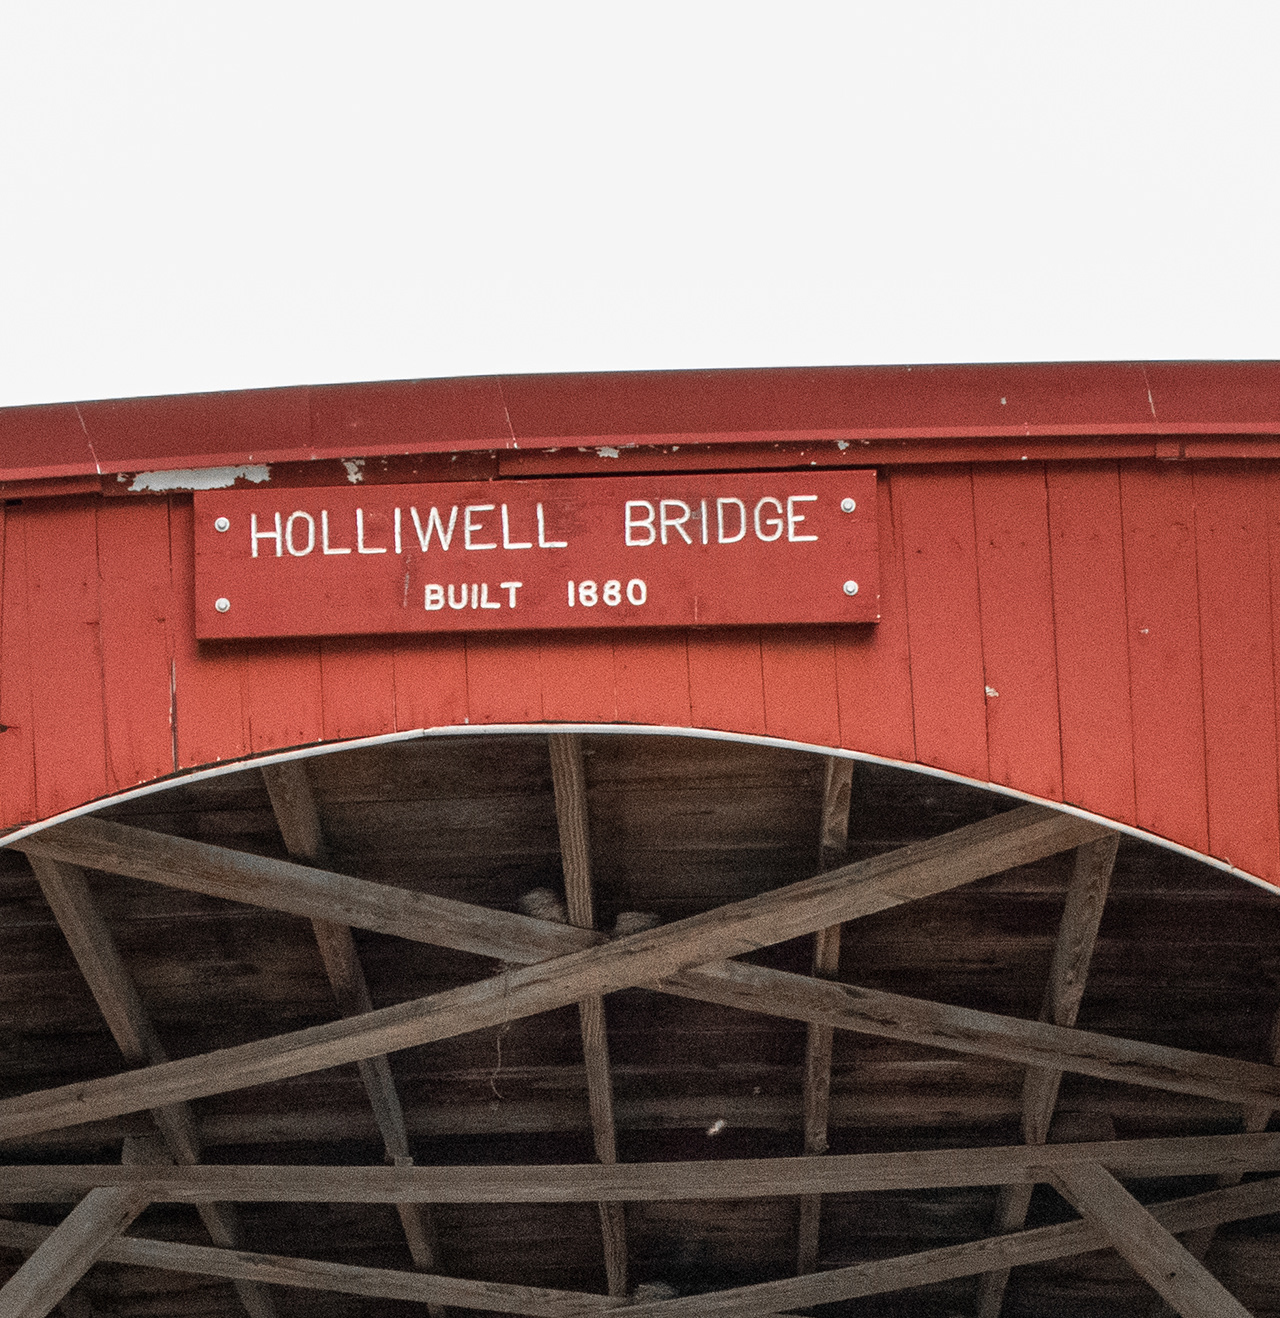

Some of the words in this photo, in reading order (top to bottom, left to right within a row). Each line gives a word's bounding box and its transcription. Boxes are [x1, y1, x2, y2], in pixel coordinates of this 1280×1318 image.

[249, 502, 568, 558] HOLLIWELL
[624, 494, 819, 546] BRIDGE
[424, 581, 523, 611] BUILT
[567, 578, 647, 607] 1880
